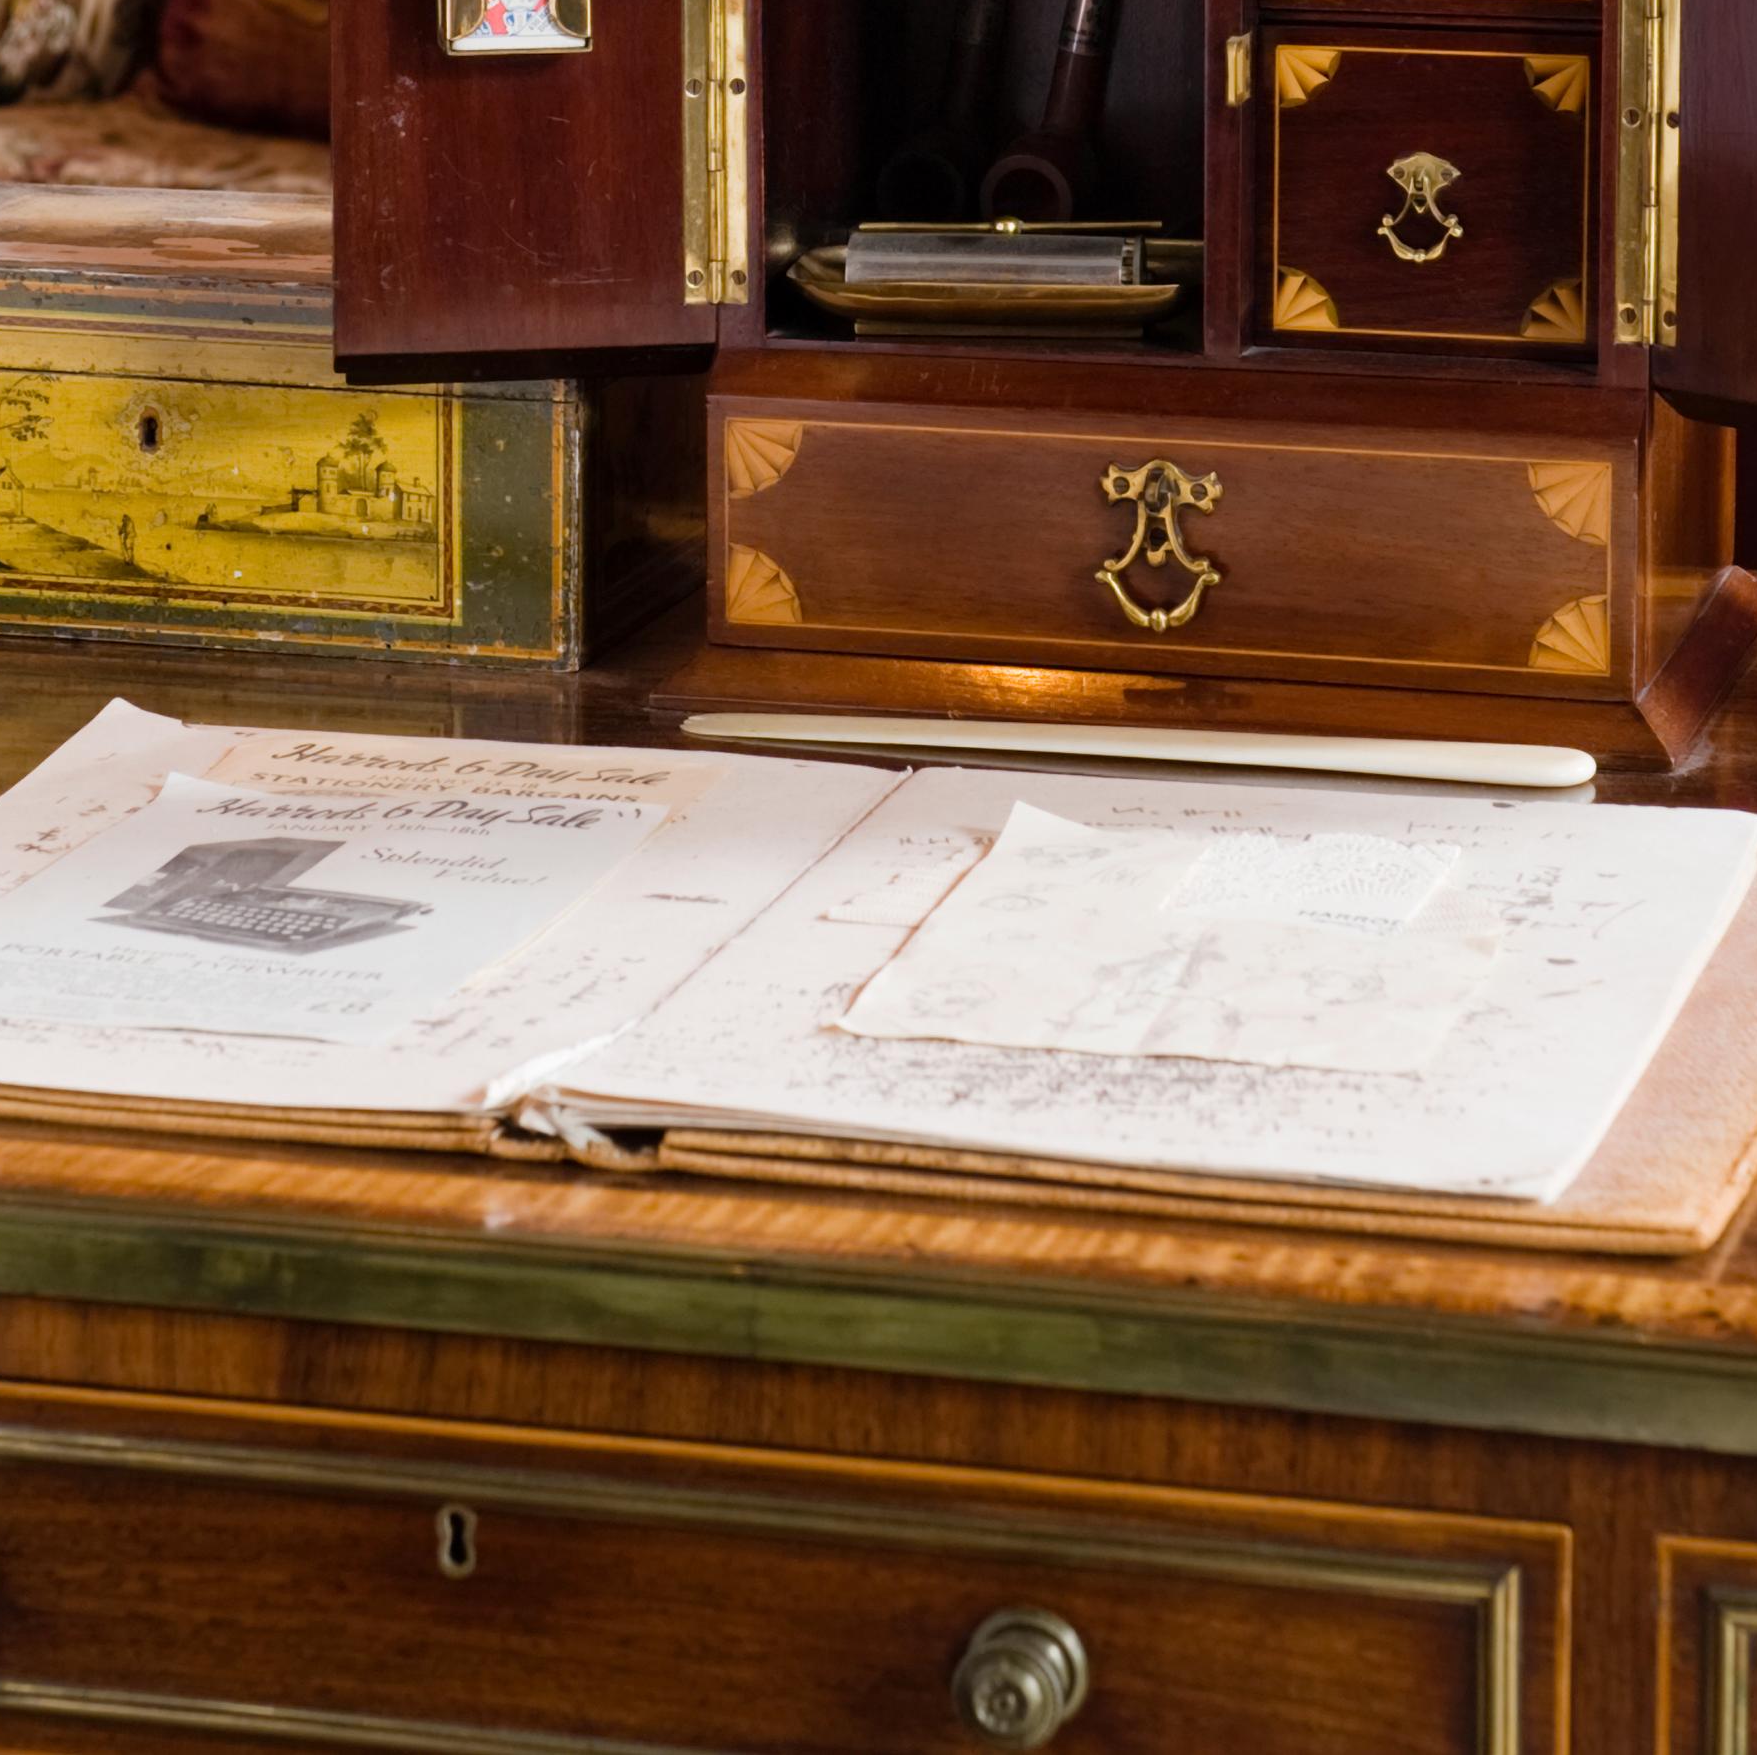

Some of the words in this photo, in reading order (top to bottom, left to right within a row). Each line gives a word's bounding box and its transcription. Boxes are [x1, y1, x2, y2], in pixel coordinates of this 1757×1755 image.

[271, 742, 452, 775] Harrods
[455, 754, 584, 785] 6-Day
[582, 766, 673, 787] Sale
[249, 771, 455, 794] STATIONERY
[470, 787, 640, 803] BARGAINS
[196, 797, 381, 823] Harrods
[382, 800, 514, 827] 6-Day
[509, 804, 604, 831] Sale
[359, 846, 508, 870] Splendid
